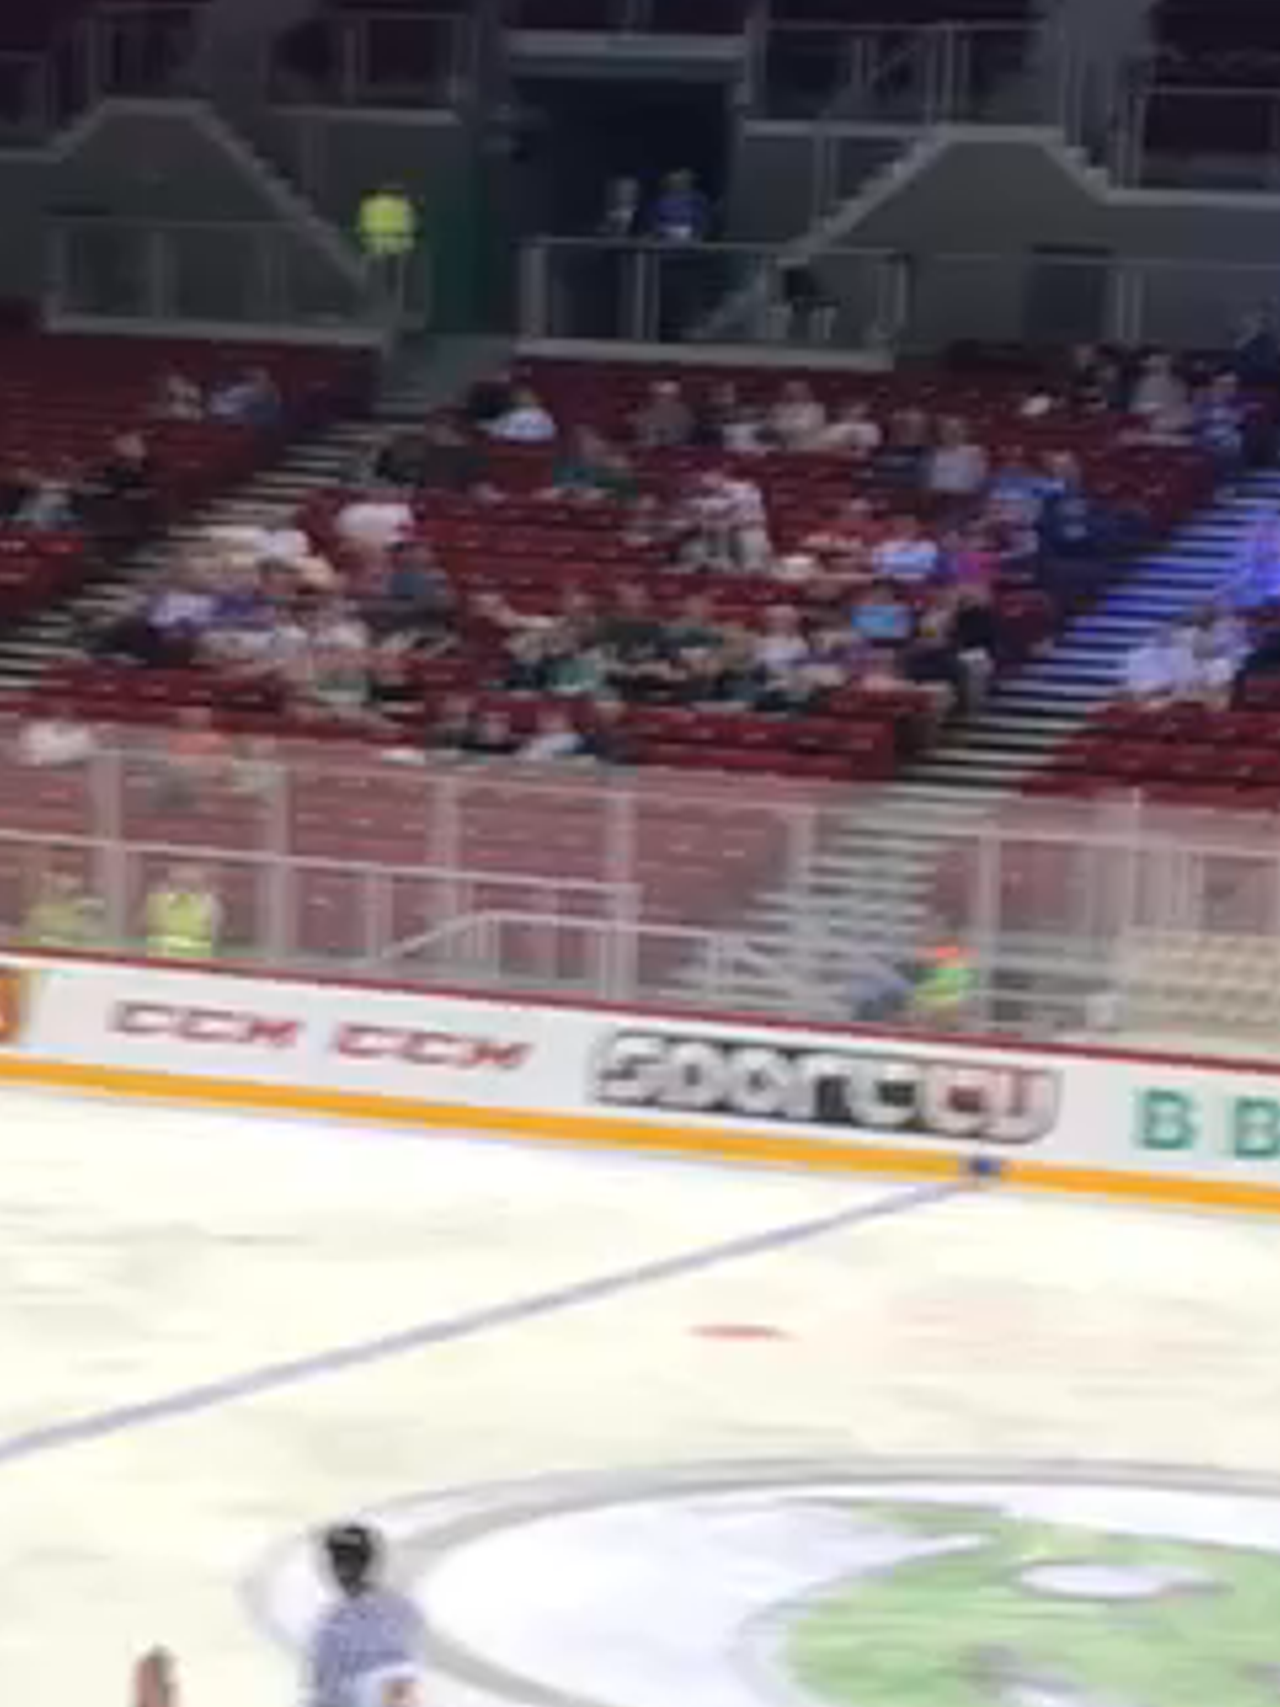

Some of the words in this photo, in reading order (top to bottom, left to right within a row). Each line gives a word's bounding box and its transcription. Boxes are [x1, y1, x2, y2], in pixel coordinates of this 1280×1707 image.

[112, 998, 304, 1050] CCM
[330, 1022, 532, 1072] CCM
[1133, 1086, 1202, 1151] B
